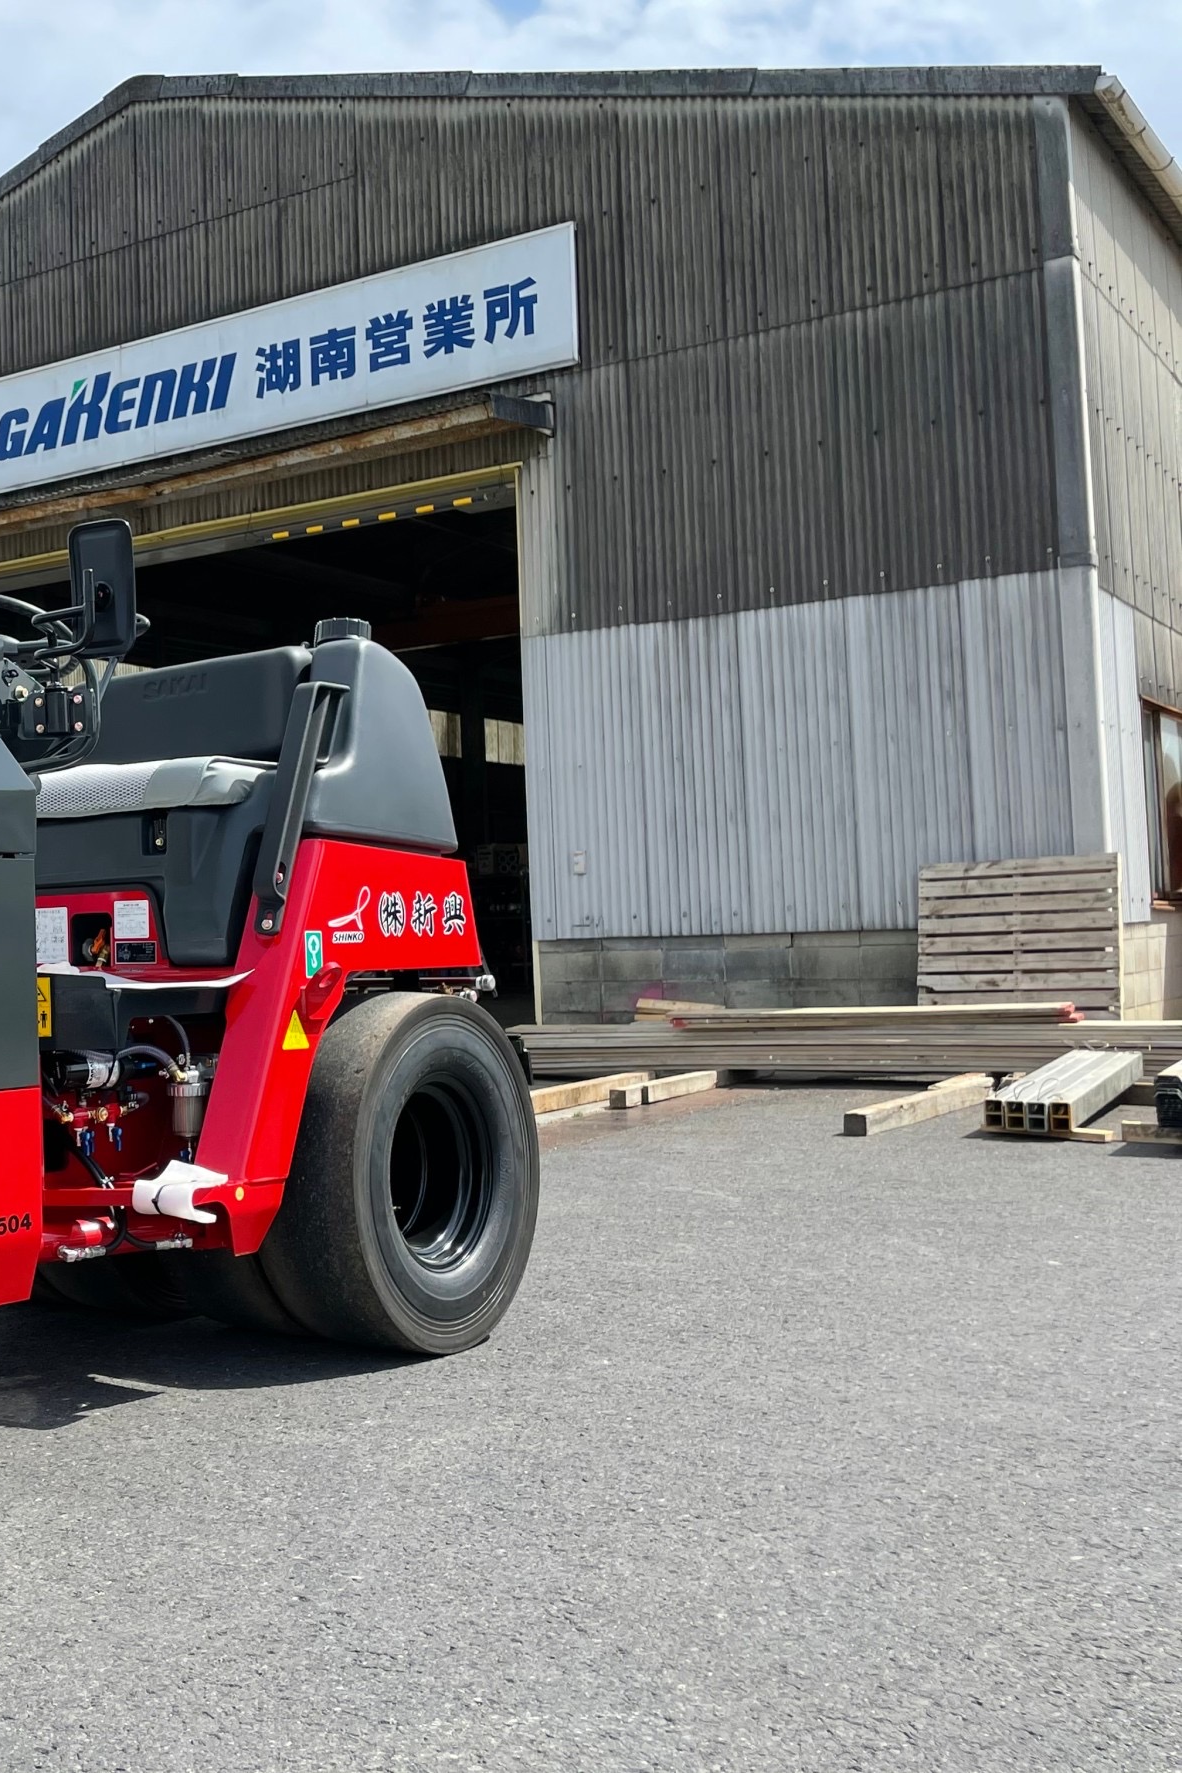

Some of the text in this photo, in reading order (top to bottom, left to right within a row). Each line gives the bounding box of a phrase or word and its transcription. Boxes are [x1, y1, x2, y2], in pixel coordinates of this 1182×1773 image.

[255, 277, 538, 399] 湖南営業所
[333, 932, 364, 943] SHINKO
